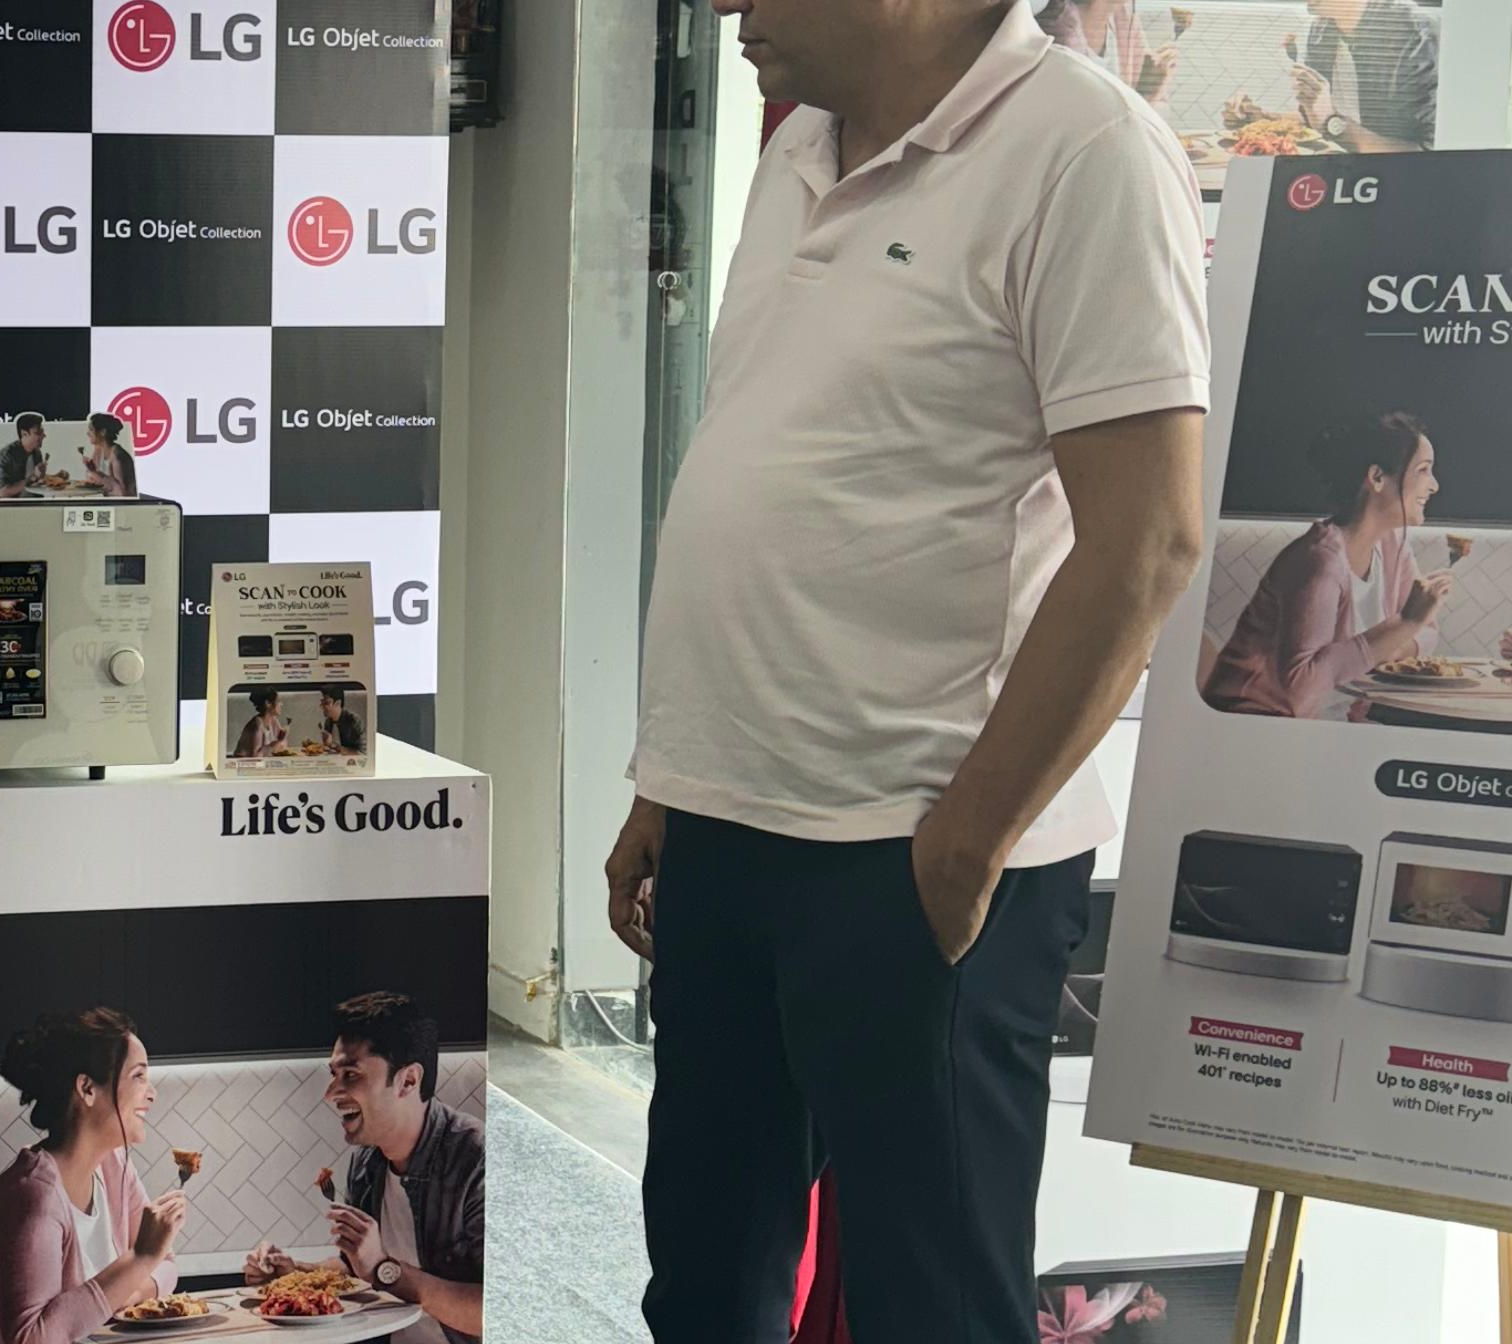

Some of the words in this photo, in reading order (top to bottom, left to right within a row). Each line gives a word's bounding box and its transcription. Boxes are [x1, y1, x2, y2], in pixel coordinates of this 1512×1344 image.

[190, 13, 261, 61] LG
[288, 28, 314, 46] LG
[383, 36, 443, 49] Collection
[1334, 177, 1378, 203] LG
[5, 206, 76, 254] LG
[368, 208, 436, 254] LG
[1424, 321, 1481, 344] with
[187, 398, 256, 443] LG
[282, 410, 308, 427] LG
[376, 416, 435, 426] Collection
[234, 573, 246, 581] LG
[239, 584, 284, 600] SCAN
[299, 586, 346, 598] COOK
[1397, 769, 1428, 788] LG
[1438, 773, 1501, 797] Objet
[221, 792, 325, 836] Life's
[335, 788, 462, 832] Good.
[1198, 1021, 1294, 1047] Convenience
[1194, 1043, 1231, 1061] Wi-Fi
[1233, 1052, 1292, 1069] enabled
[1422, 1054, 1473, 1074] Health
[1229, 1071, 1281, 1088] recipes
[1377, 1072, 1397, 1088] Up
[1400, 1076, 1416, 1089] to
[1462, 1084, 1492, 1101] less
[1392, 1096, 1422, 1111] with
[1425, 1099, 1454, 1116] Diet
